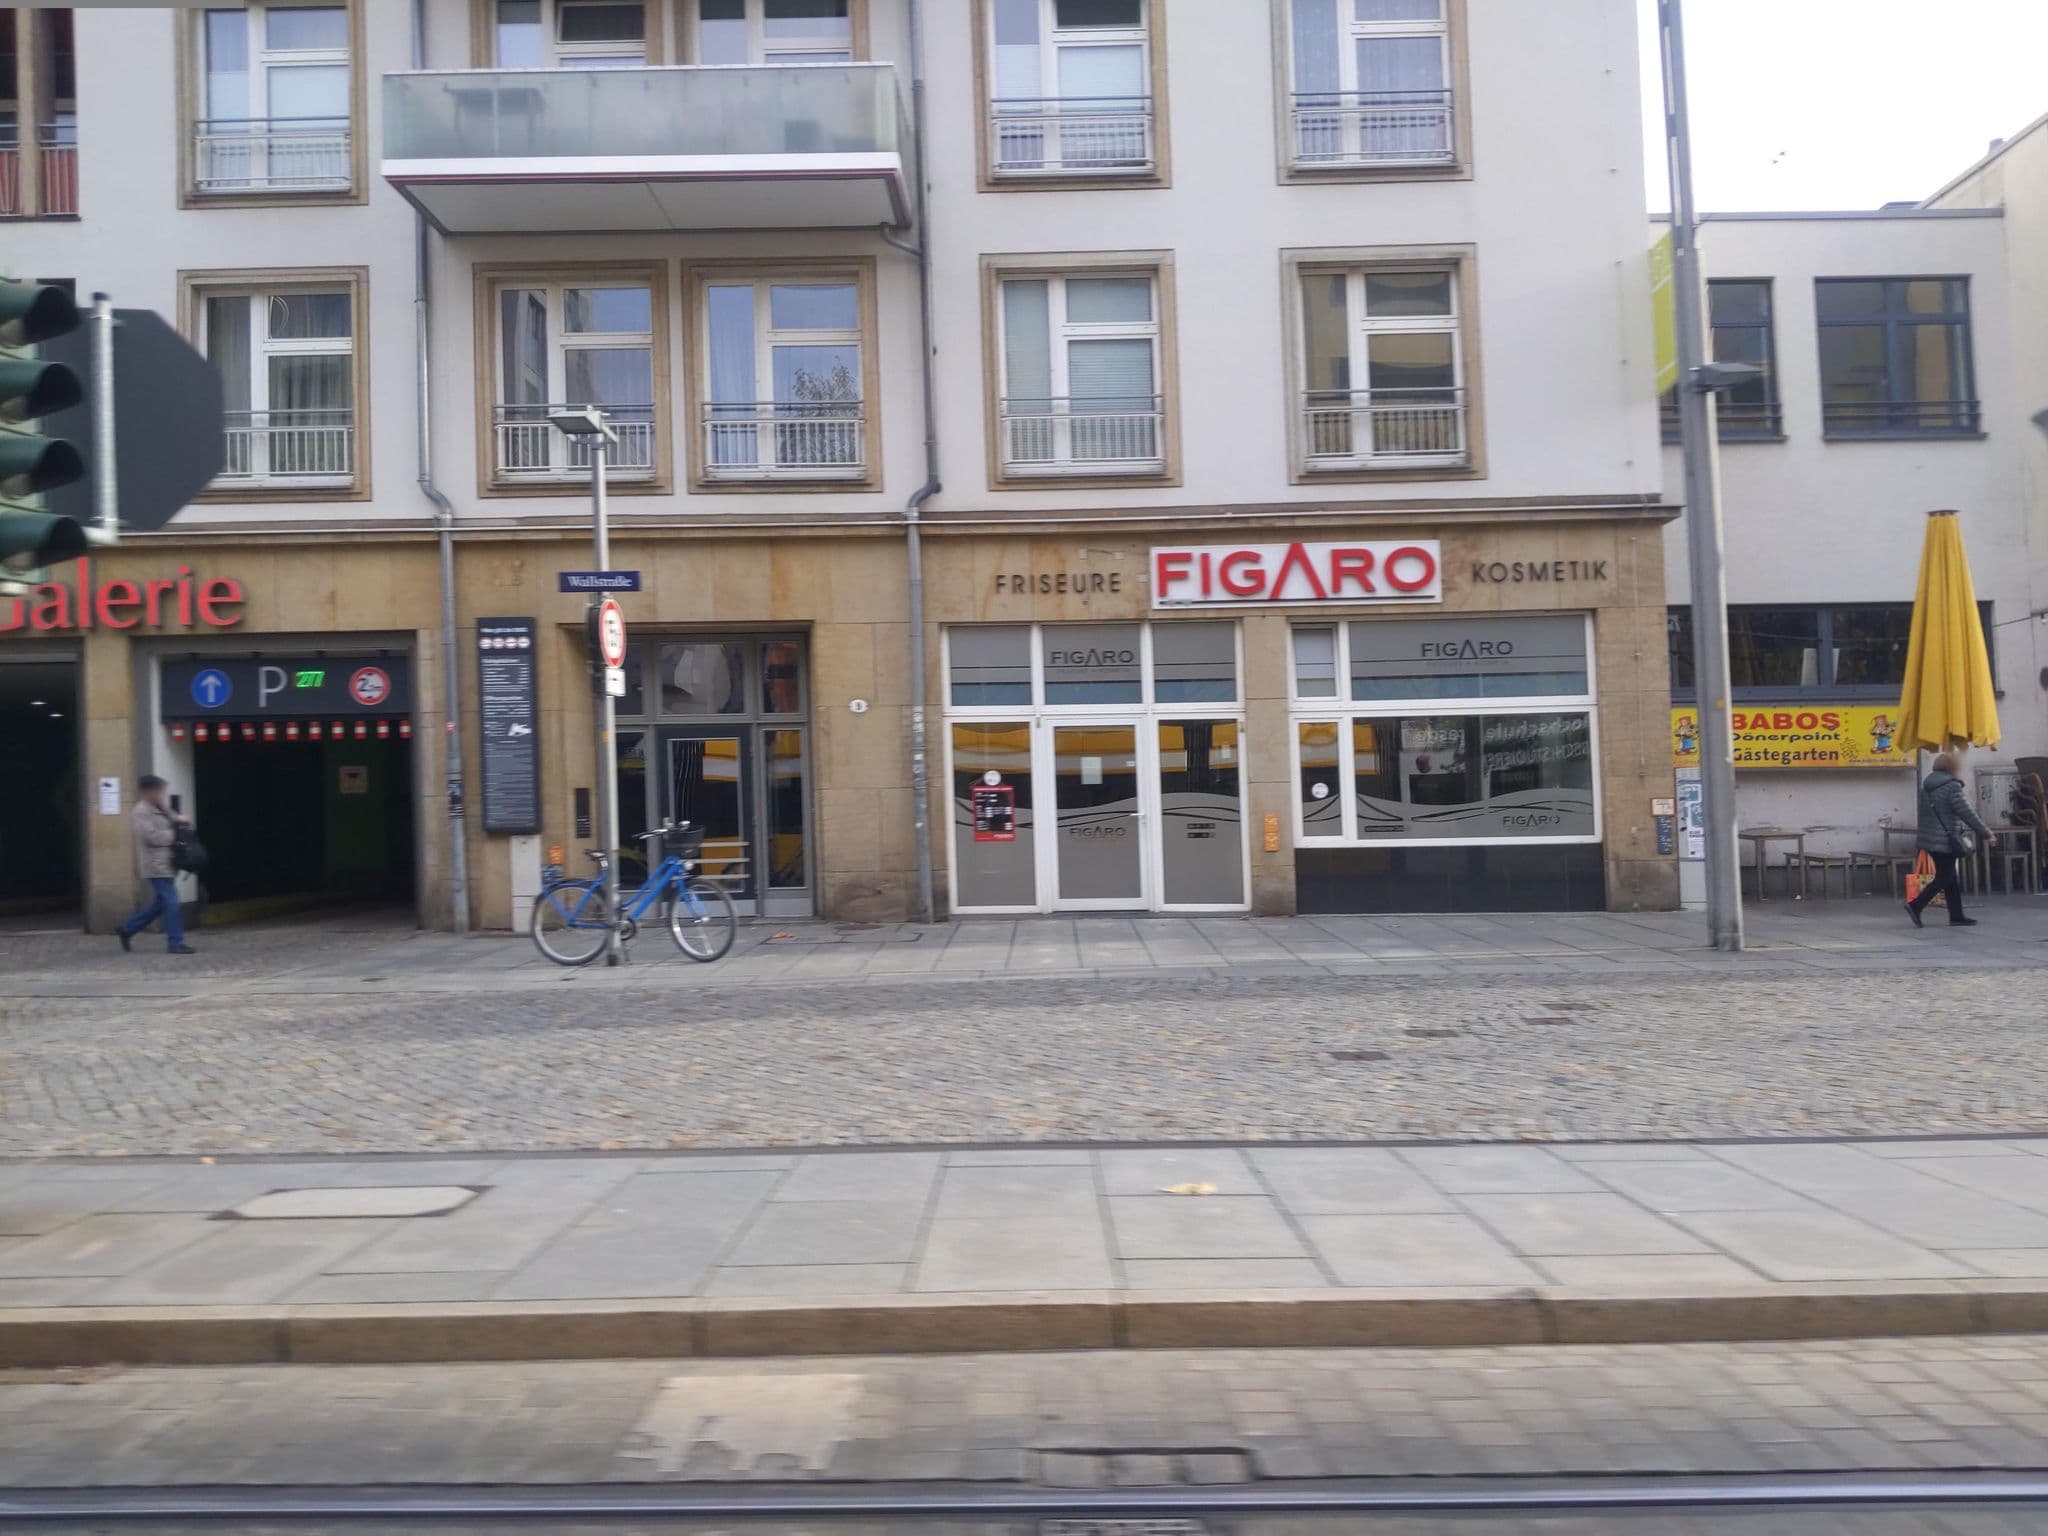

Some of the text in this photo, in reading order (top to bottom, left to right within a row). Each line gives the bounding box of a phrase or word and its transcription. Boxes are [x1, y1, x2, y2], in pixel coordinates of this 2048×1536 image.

[1157, 541, 1436, 600] FIGARO
[1472, 559, 1607, 583] KOSMETIK
[995, 572, 1121, 594] FRISEURE
[0, 556, 244, 632] alerie
[1050, 648, 1134, 666] FIGARO
[1421, 639, 1513, 660] FIGARO
[258, 665, 289, 708] P
[1731, 712, 1841, 730] BABOS
[1502, 814, 1561, 826] FIGARO
[1069, 826, 1127, 839] FIGARO
